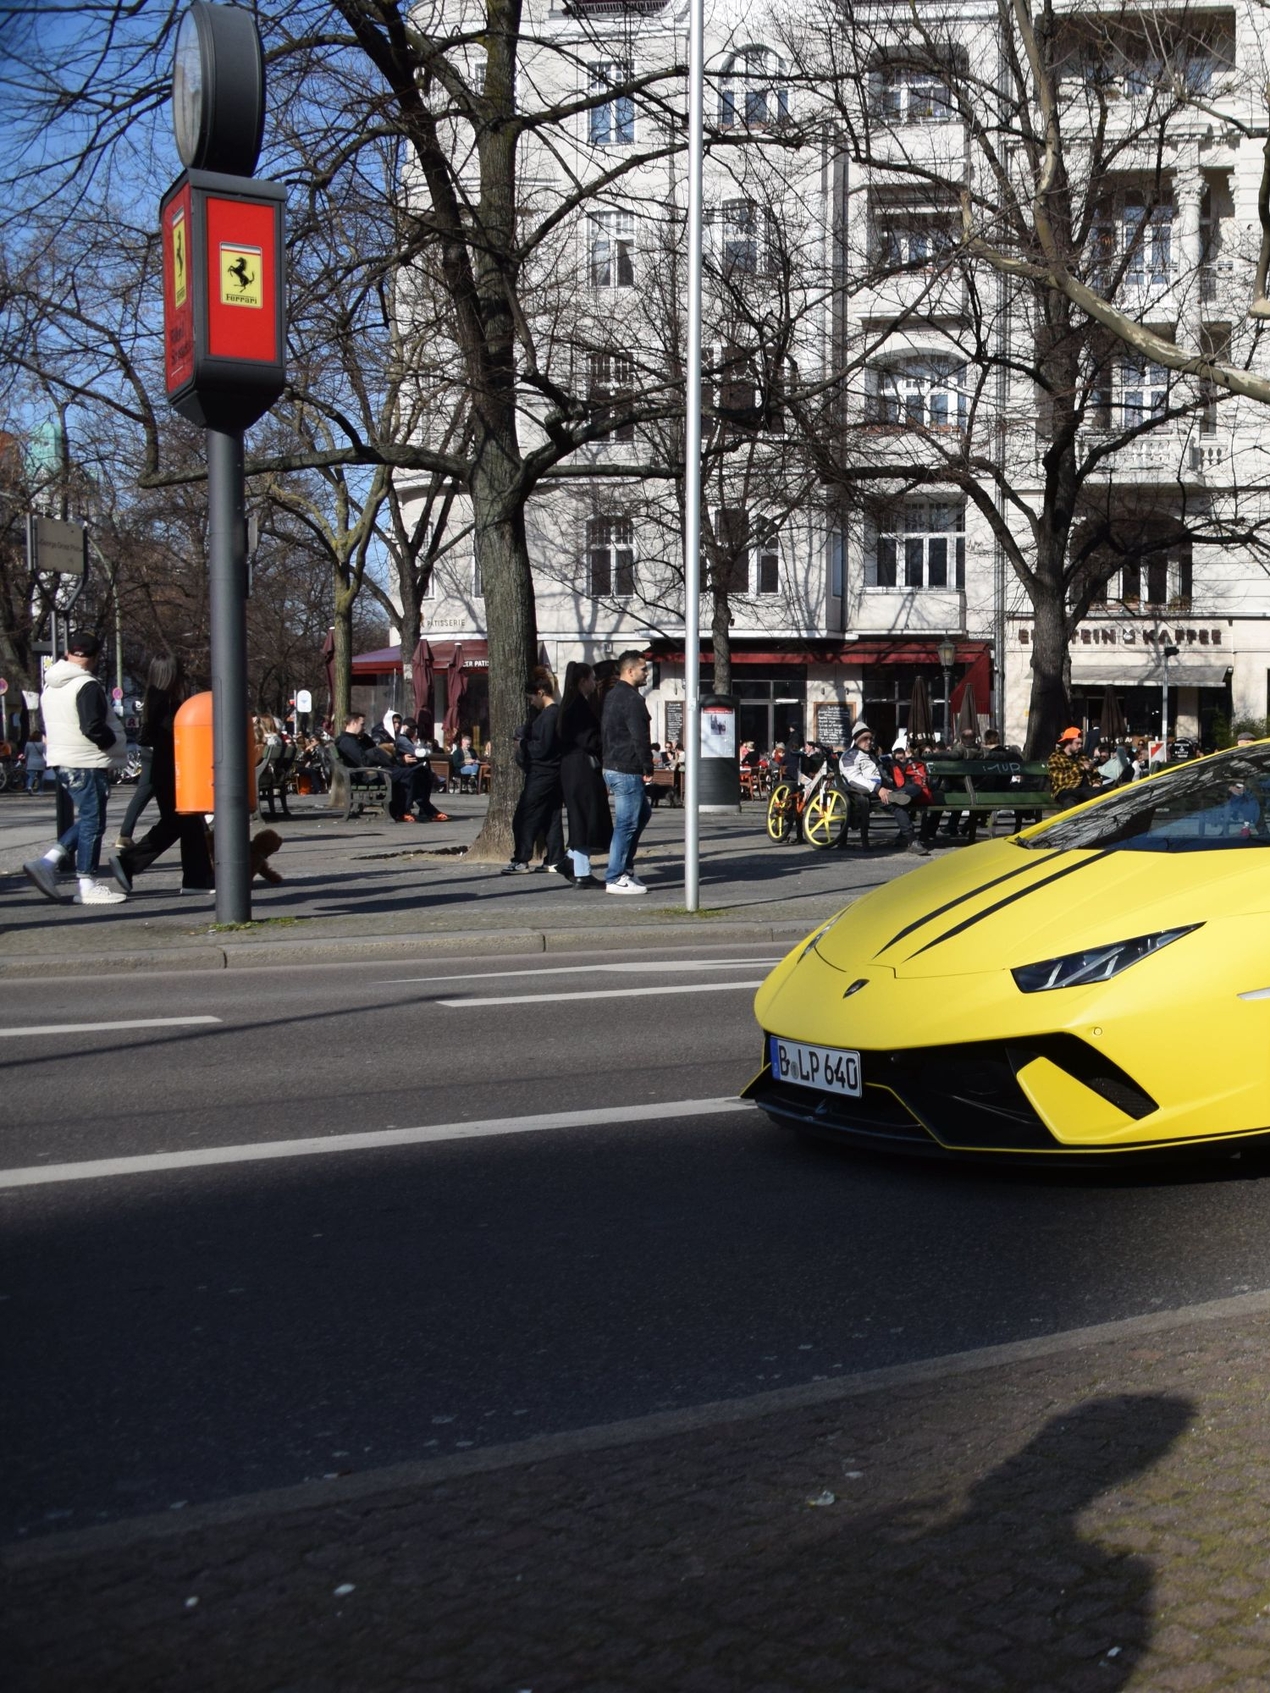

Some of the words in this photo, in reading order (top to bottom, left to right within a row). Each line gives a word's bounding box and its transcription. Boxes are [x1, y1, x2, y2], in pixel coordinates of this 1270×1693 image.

[226, 293, 257, 304] Ferrari
[427, 619, 465, 627] PATISSERIE
[1142, 628, 1222, 645] KAFFEE
[779, 1045, 790, 1076] B
[798, 1049, 820, 1082] LP
[824, 1054, 857, 1090] 640
